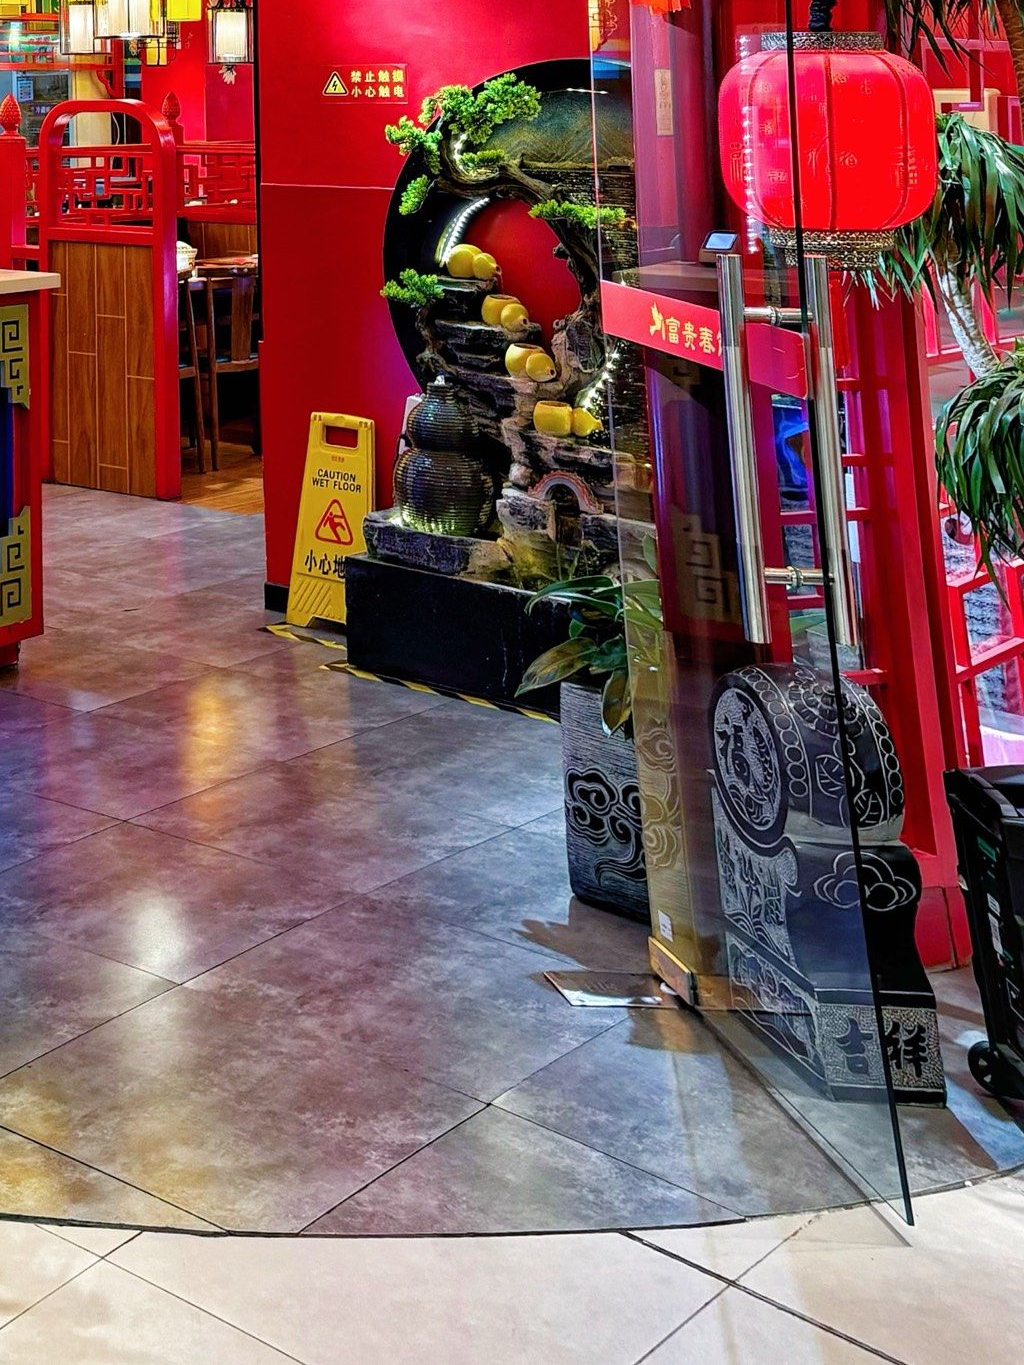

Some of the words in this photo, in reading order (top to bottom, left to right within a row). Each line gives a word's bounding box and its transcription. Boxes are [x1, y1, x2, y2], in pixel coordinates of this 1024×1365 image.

[351, 85, 404, 98] 小心触电
[665, 316, 723, 357] 富贵春
[318, 469, 356, 482] CAUTION
[313, 477, 330, 488] WET
[334, 481, 362, 493] FLOOR
